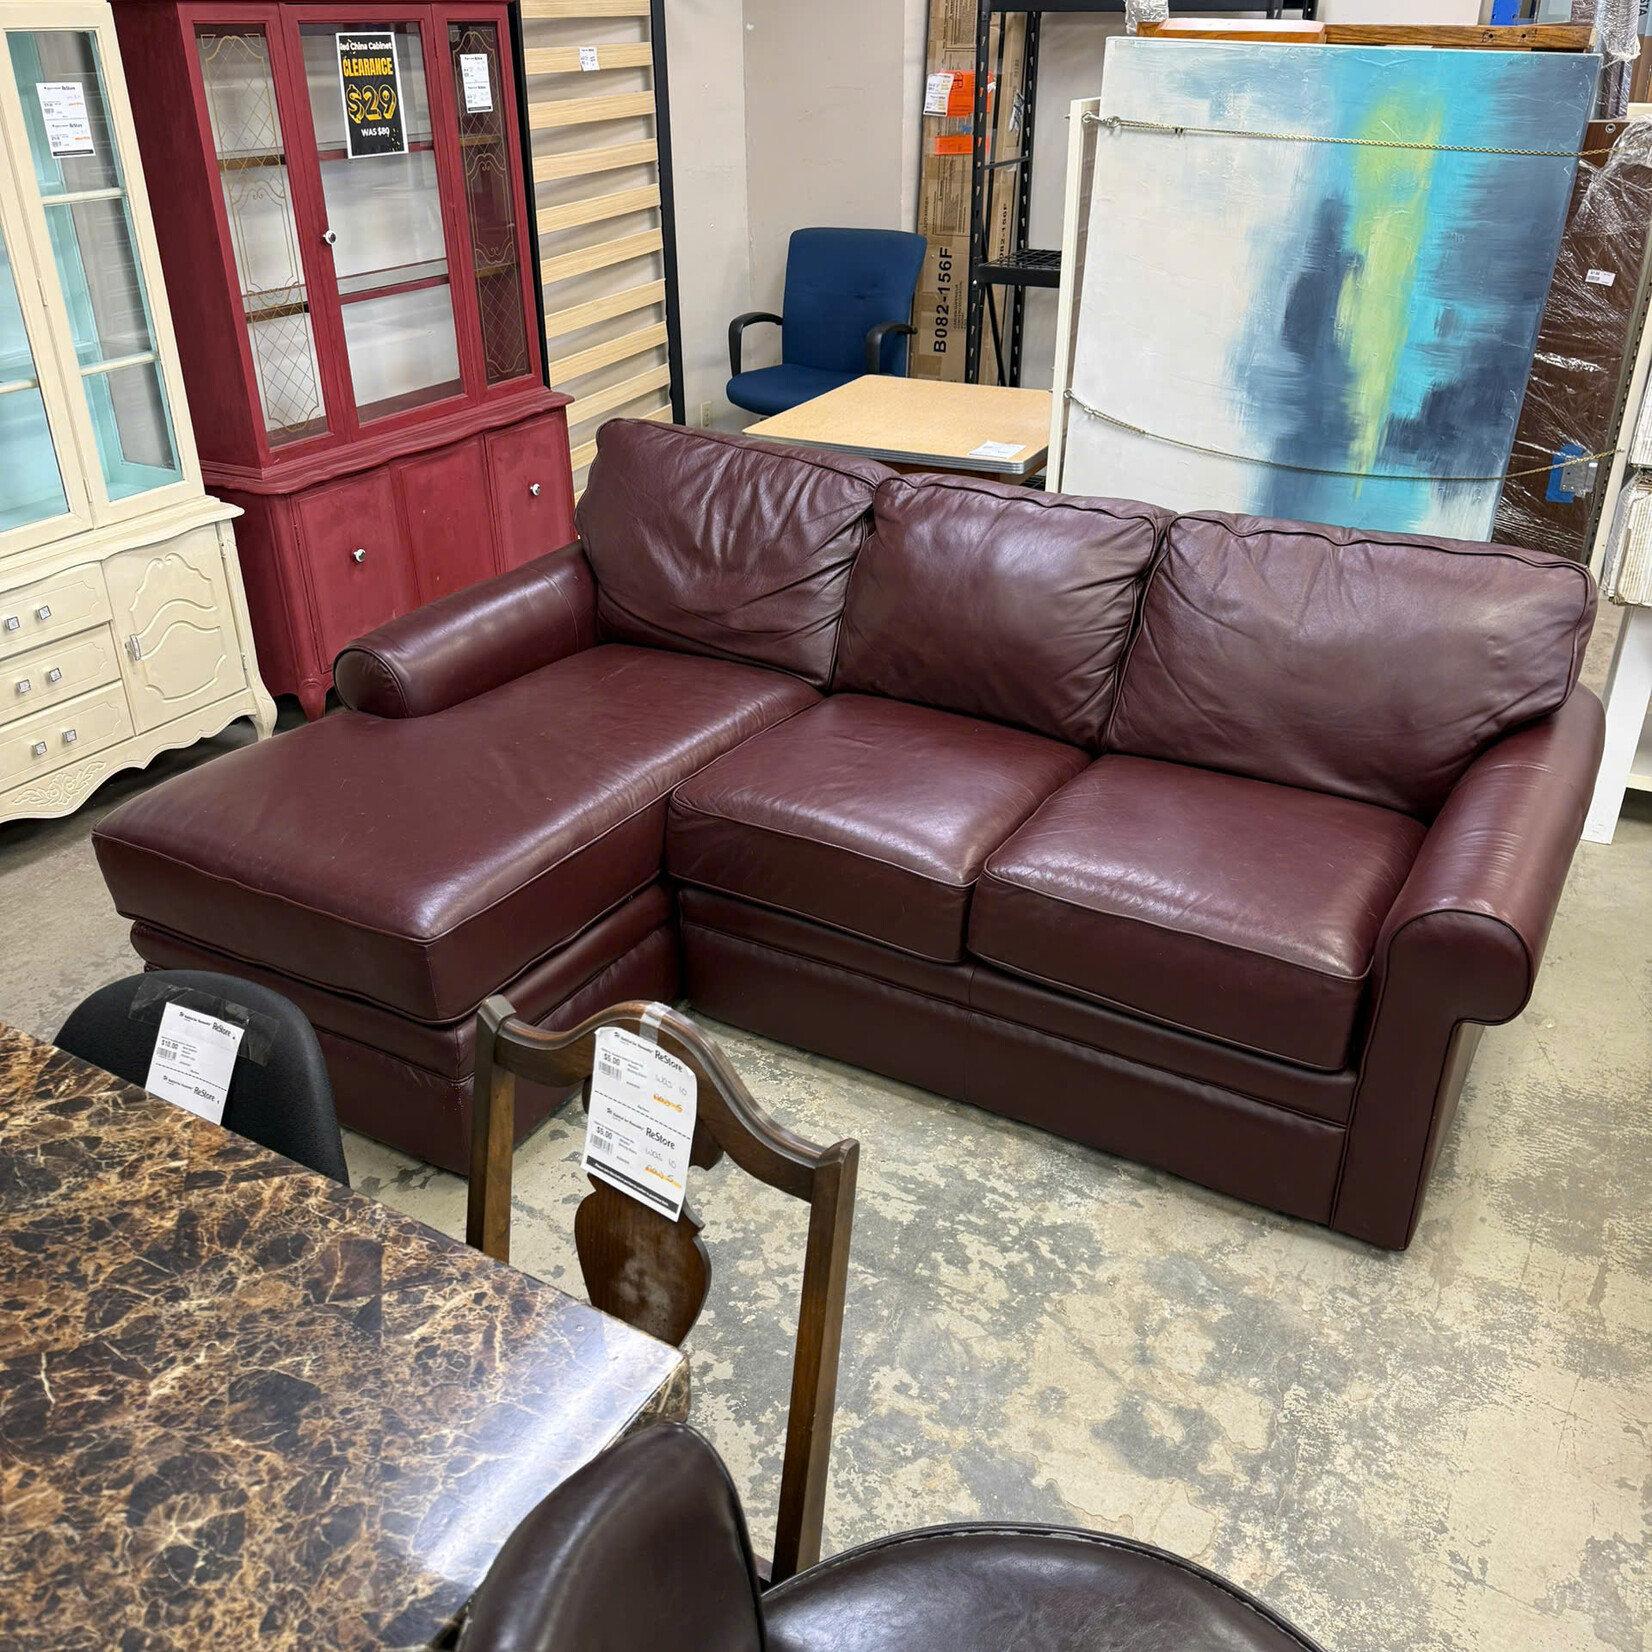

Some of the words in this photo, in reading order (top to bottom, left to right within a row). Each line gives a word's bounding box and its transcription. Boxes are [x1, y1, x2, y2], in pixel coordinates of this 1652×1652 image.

[350, 42, 368, 50] China
[368, 41, 393, 50] Cabinet
[342, 57, 393, 77] CLEARANCE
[346, 84, 397, 124] $29
[361, 128, 377, 137] WAS
[933, 247, 952, 353] B082-156F
[604, 1053, 621, 1066] $5.00
[655, 1050, 683, 1072] ReStore
[193, 1086, 216, 1102] ReStore
[596, 1126, 613, 1140] $5.00
[645, 1127, 675, 1149] ReStore
